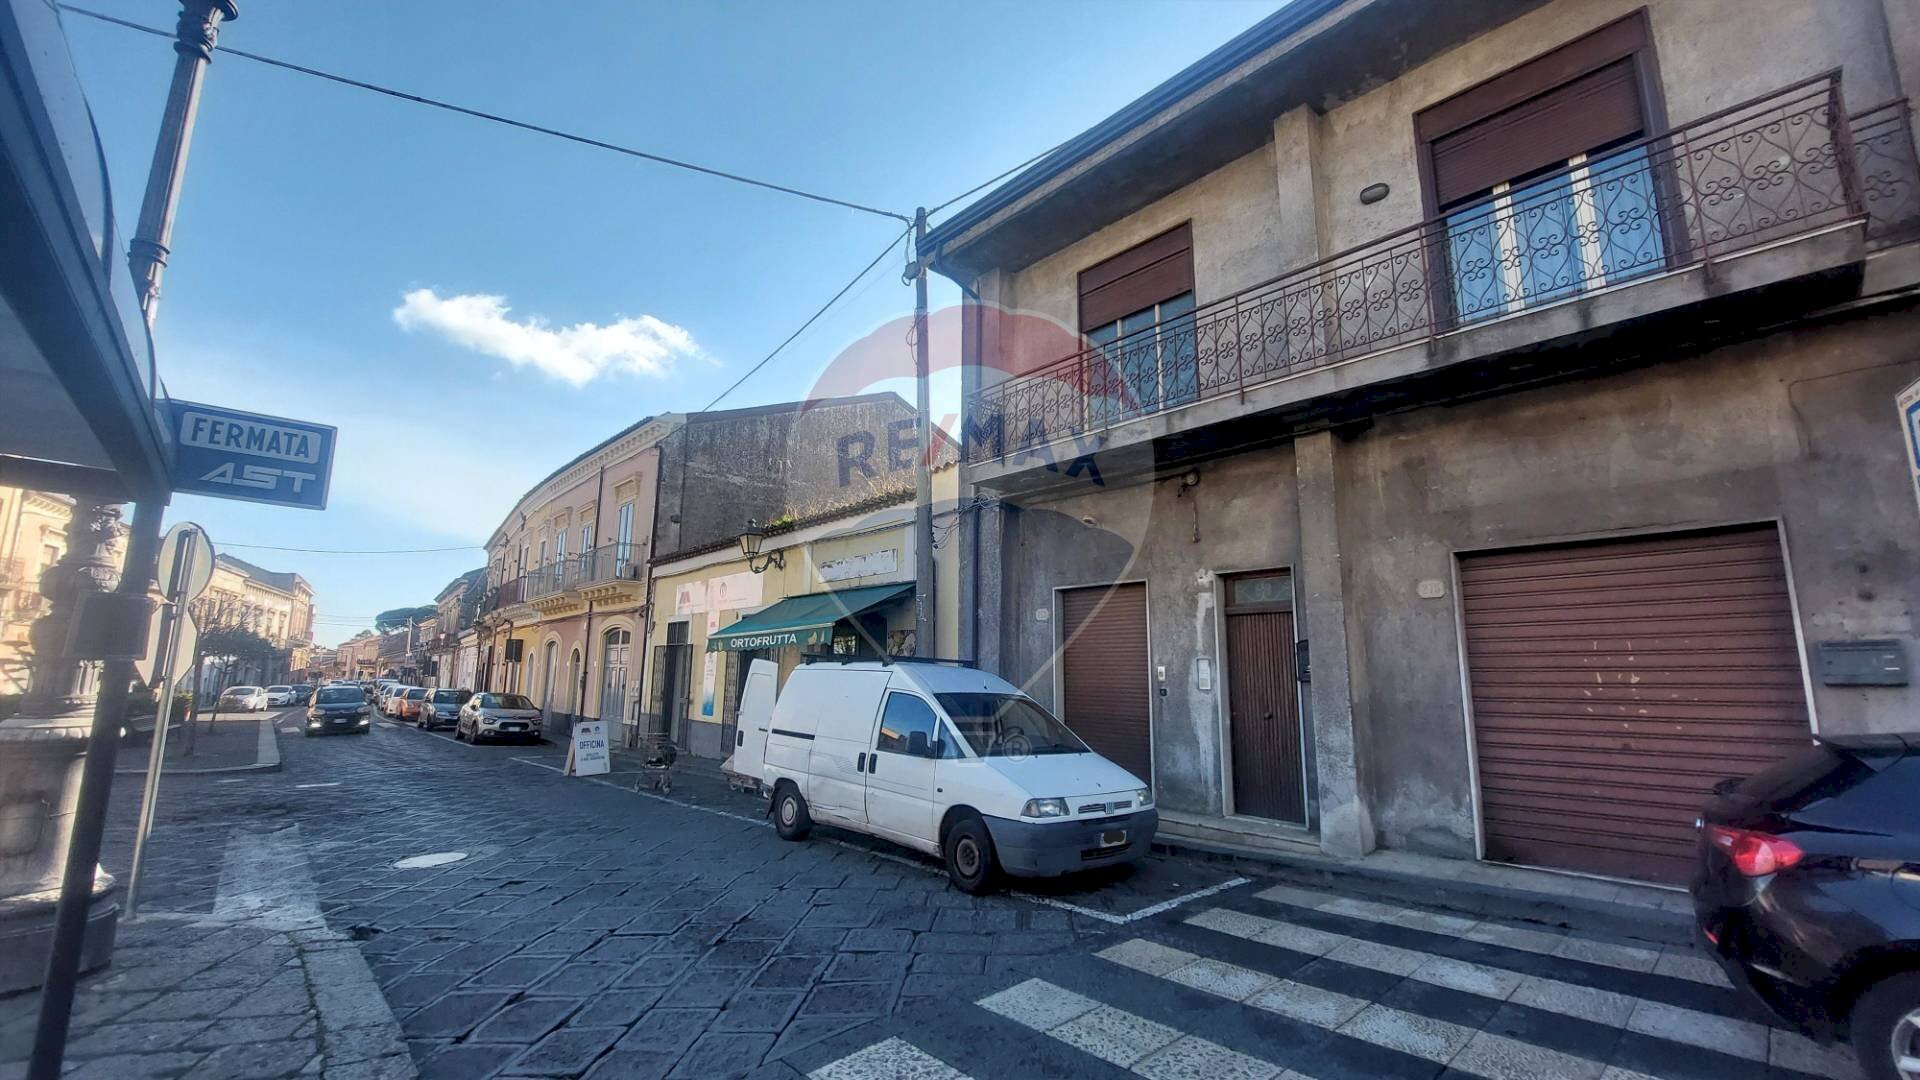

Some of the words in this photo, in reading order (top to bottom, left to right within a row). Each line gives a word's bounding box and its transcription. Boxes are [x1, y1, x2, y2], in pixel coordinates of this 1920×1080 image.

[191, 417, 310, 459] FERMATA
[199, 462, 316, 493] AST
[730, 633, 797, 648] ORTOFRUTTA
[579, 740, 605, 750] OFFICINA
